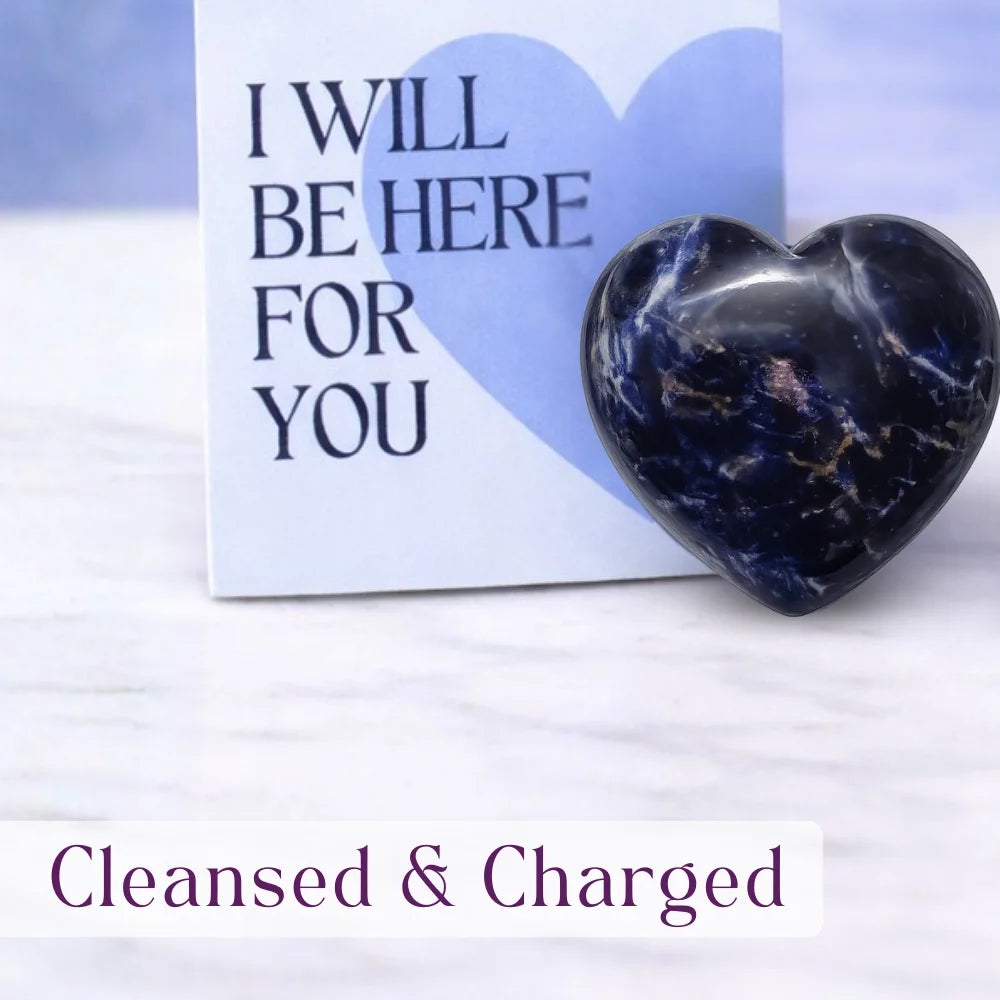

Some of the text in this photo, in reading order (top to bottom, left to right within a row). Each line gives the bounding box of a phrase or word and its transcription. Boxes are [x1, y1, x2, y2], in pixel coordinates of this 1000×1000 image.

[246, 75, 508, 159] I WILL
[249, 171, 593, 260] BE HERE
[253, 280, 419, 361] FOR
[252, 379, 430, 461] YOU
